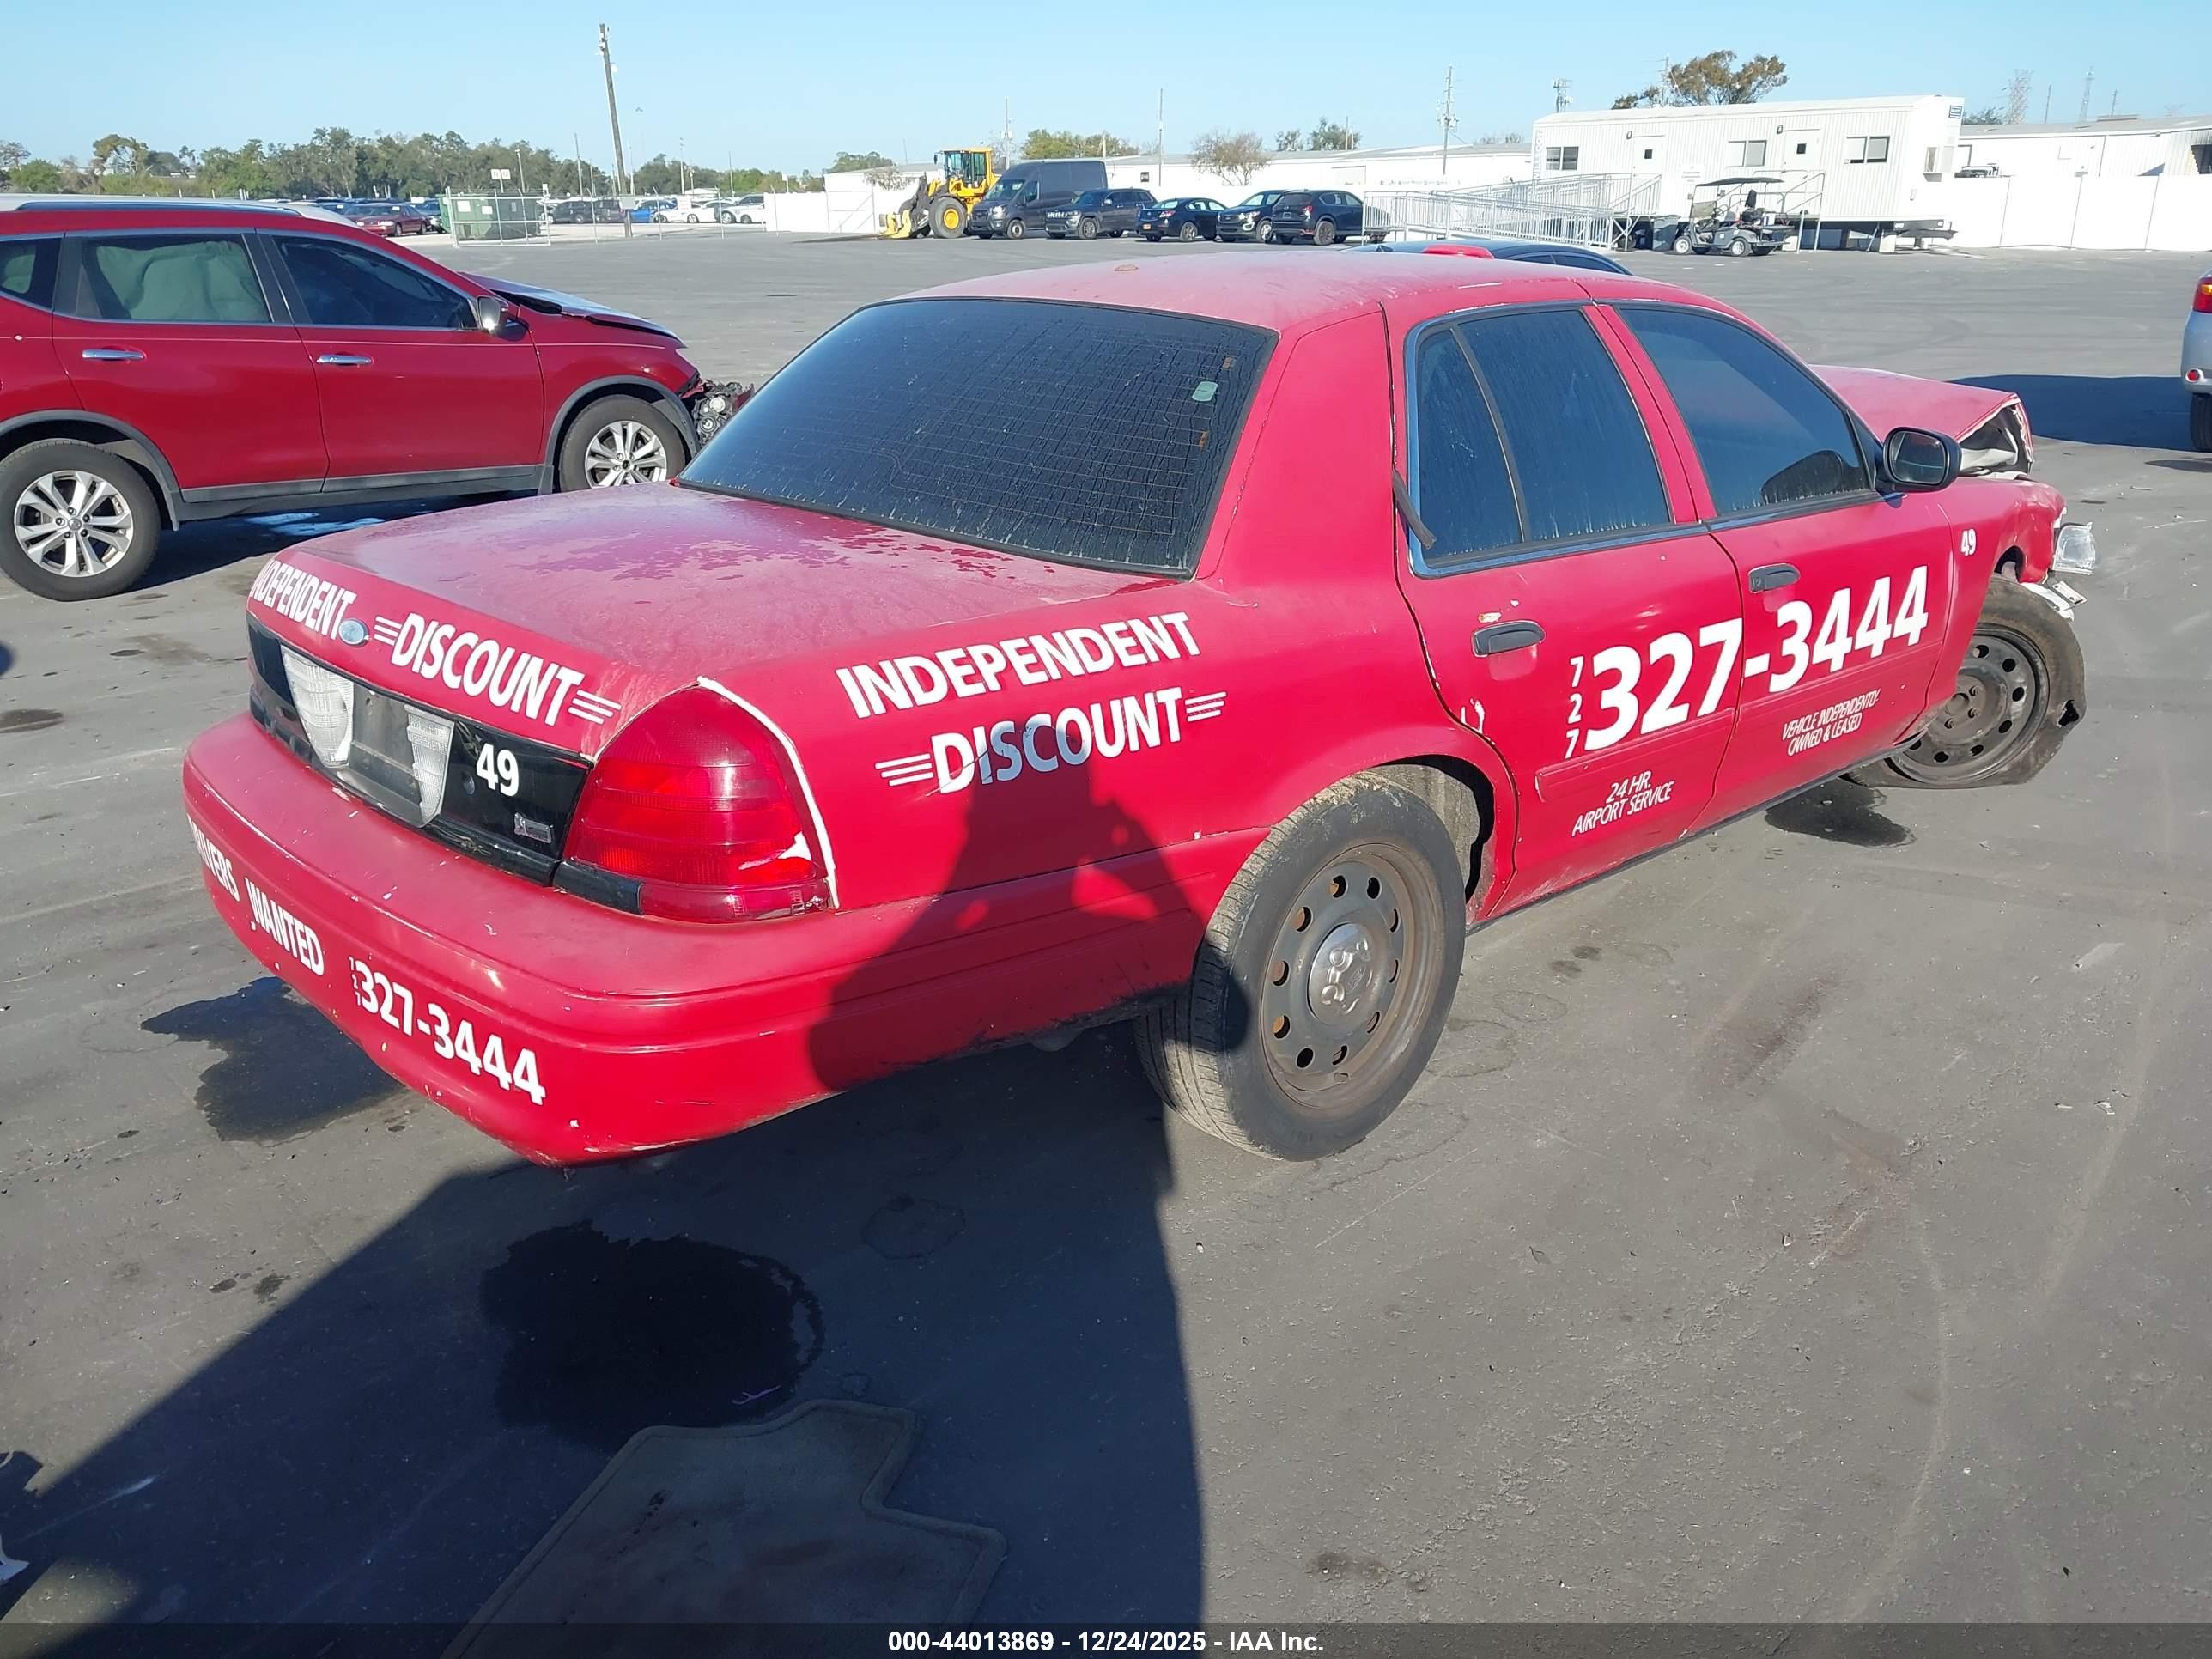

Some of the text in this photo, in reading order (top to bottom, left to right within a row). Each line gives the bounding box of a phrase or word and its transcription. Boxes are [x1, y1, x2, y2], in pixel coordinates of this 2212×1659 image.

[1960, 528, 1977, 556] 49
[249, 558, 358, 641] NDEPENDENT
[391, 612, 586, 726] DISCOUNT
[835, 611, 1201, 719] INDEPENDENT
[1584, 565, 1929, 751] 327-3444
[931, 687, 1182, 795] DISCOUNT
[1782, 711, 1820, 741] VEHICLE
[1787, 712, 1863, 757] OWNED & LEASED
[476, 744, 519, 796] 49
[1571, 781, 1675, 837] AIRPORT SERVICE
[1605, 770, 1652, 804] 24 HR.
[244, 877, 325, 976] WANTED
[355, 960, 545, 1106] 327-3444
